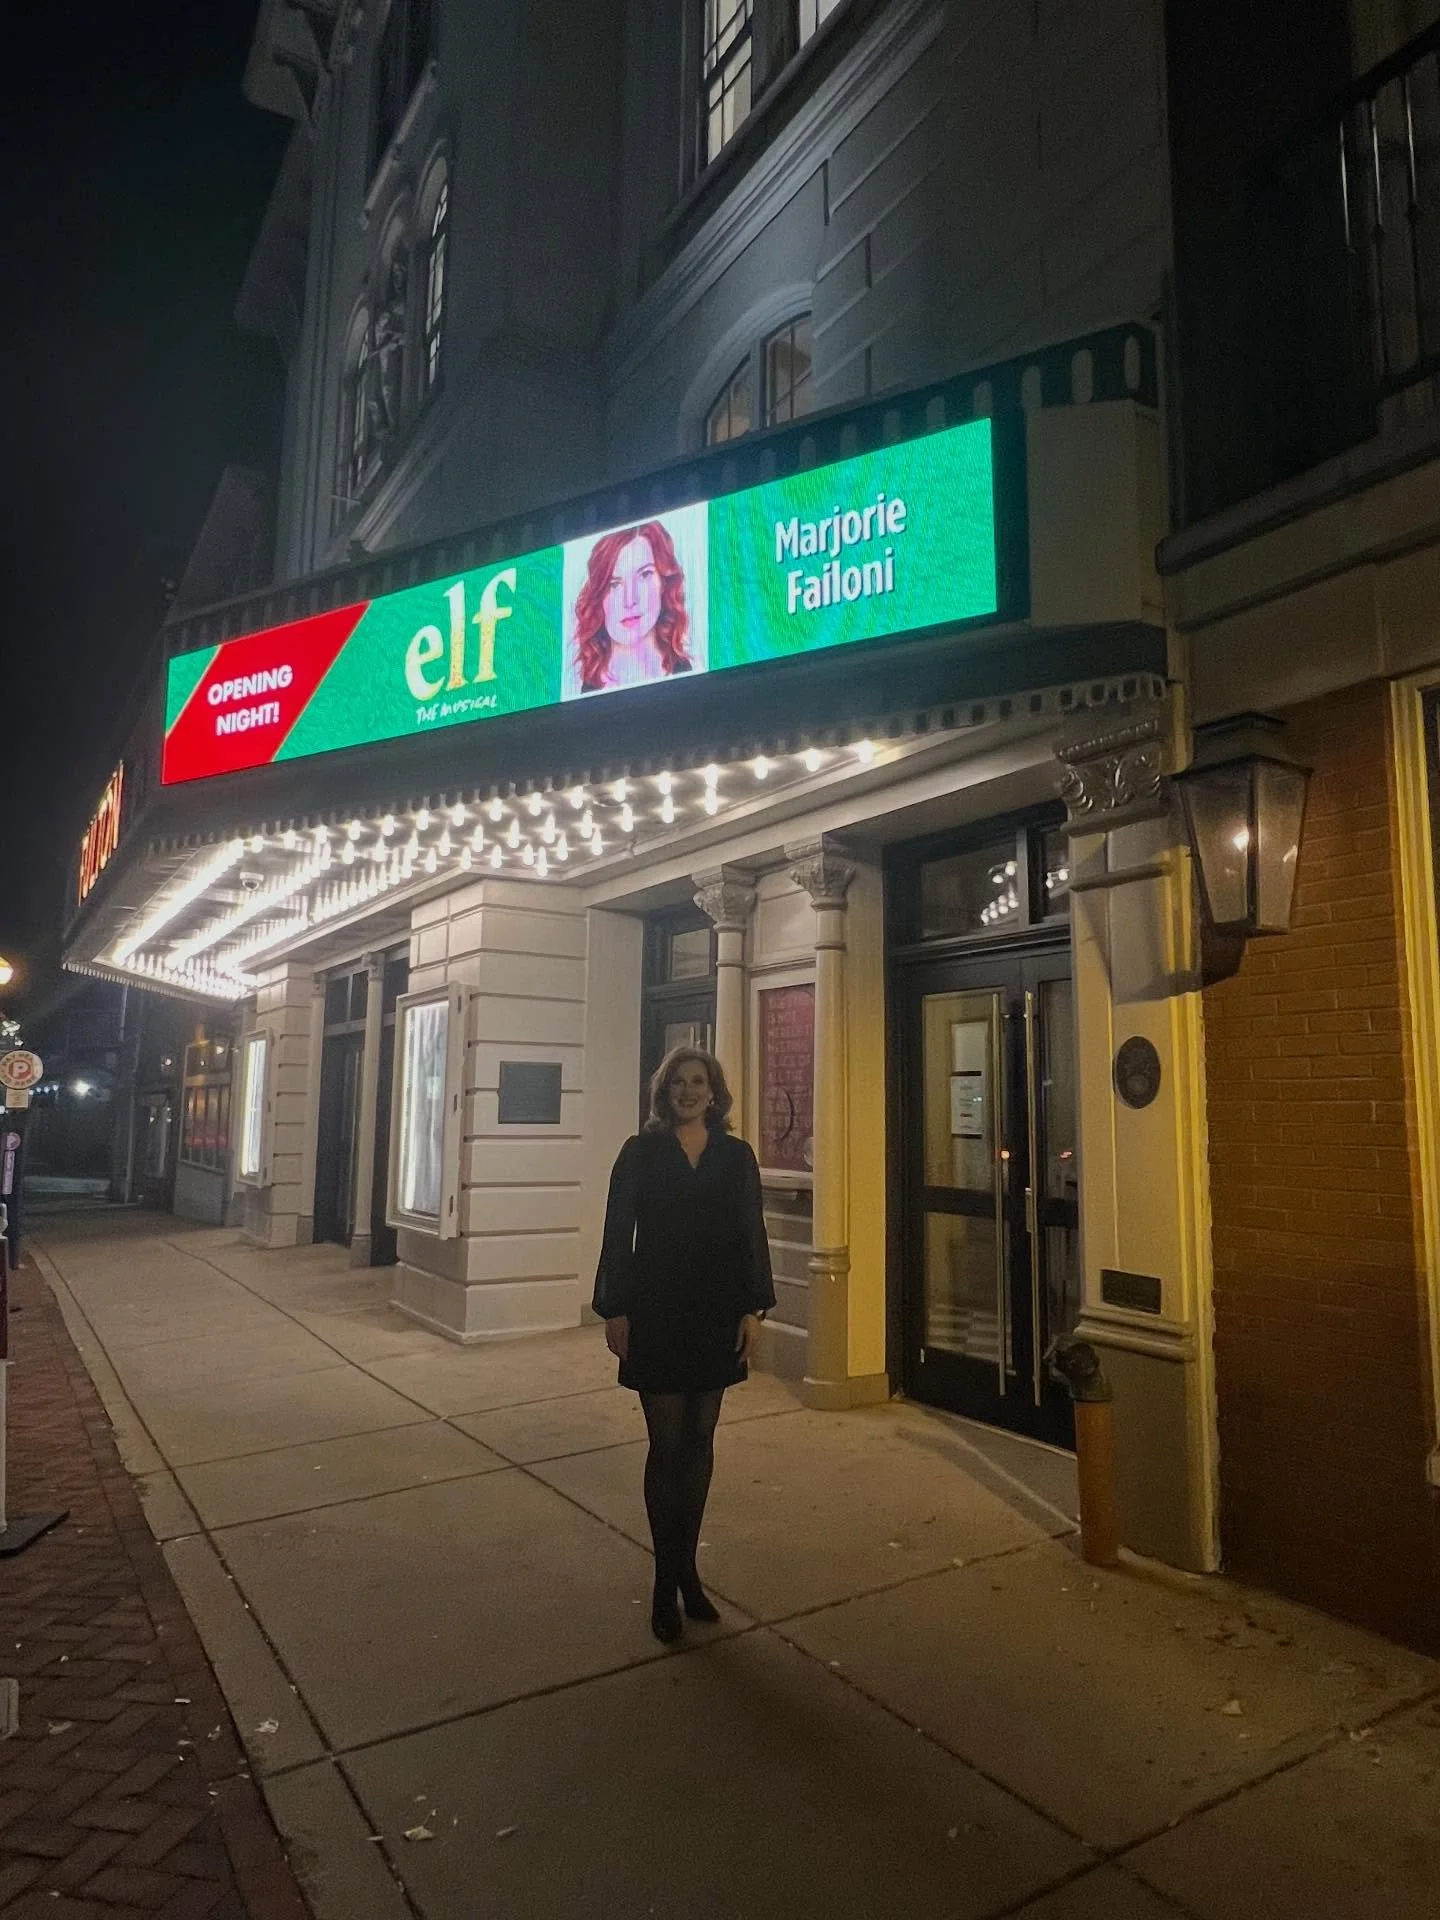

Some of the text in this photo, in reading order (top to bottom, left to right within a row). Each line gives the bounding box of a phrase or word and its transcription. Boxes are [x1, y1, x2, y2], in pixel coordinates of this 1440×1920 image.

[775, 492, 907, 563] Marjorie
[787, 547, 894, 614] Failoni
[405, 572, 517, 701] elf
[207, 664, 293, 705] OPENING
[416, 694, 498, 725] THE MUSICAL
[216, 701, 280, 736] NIGHT!
